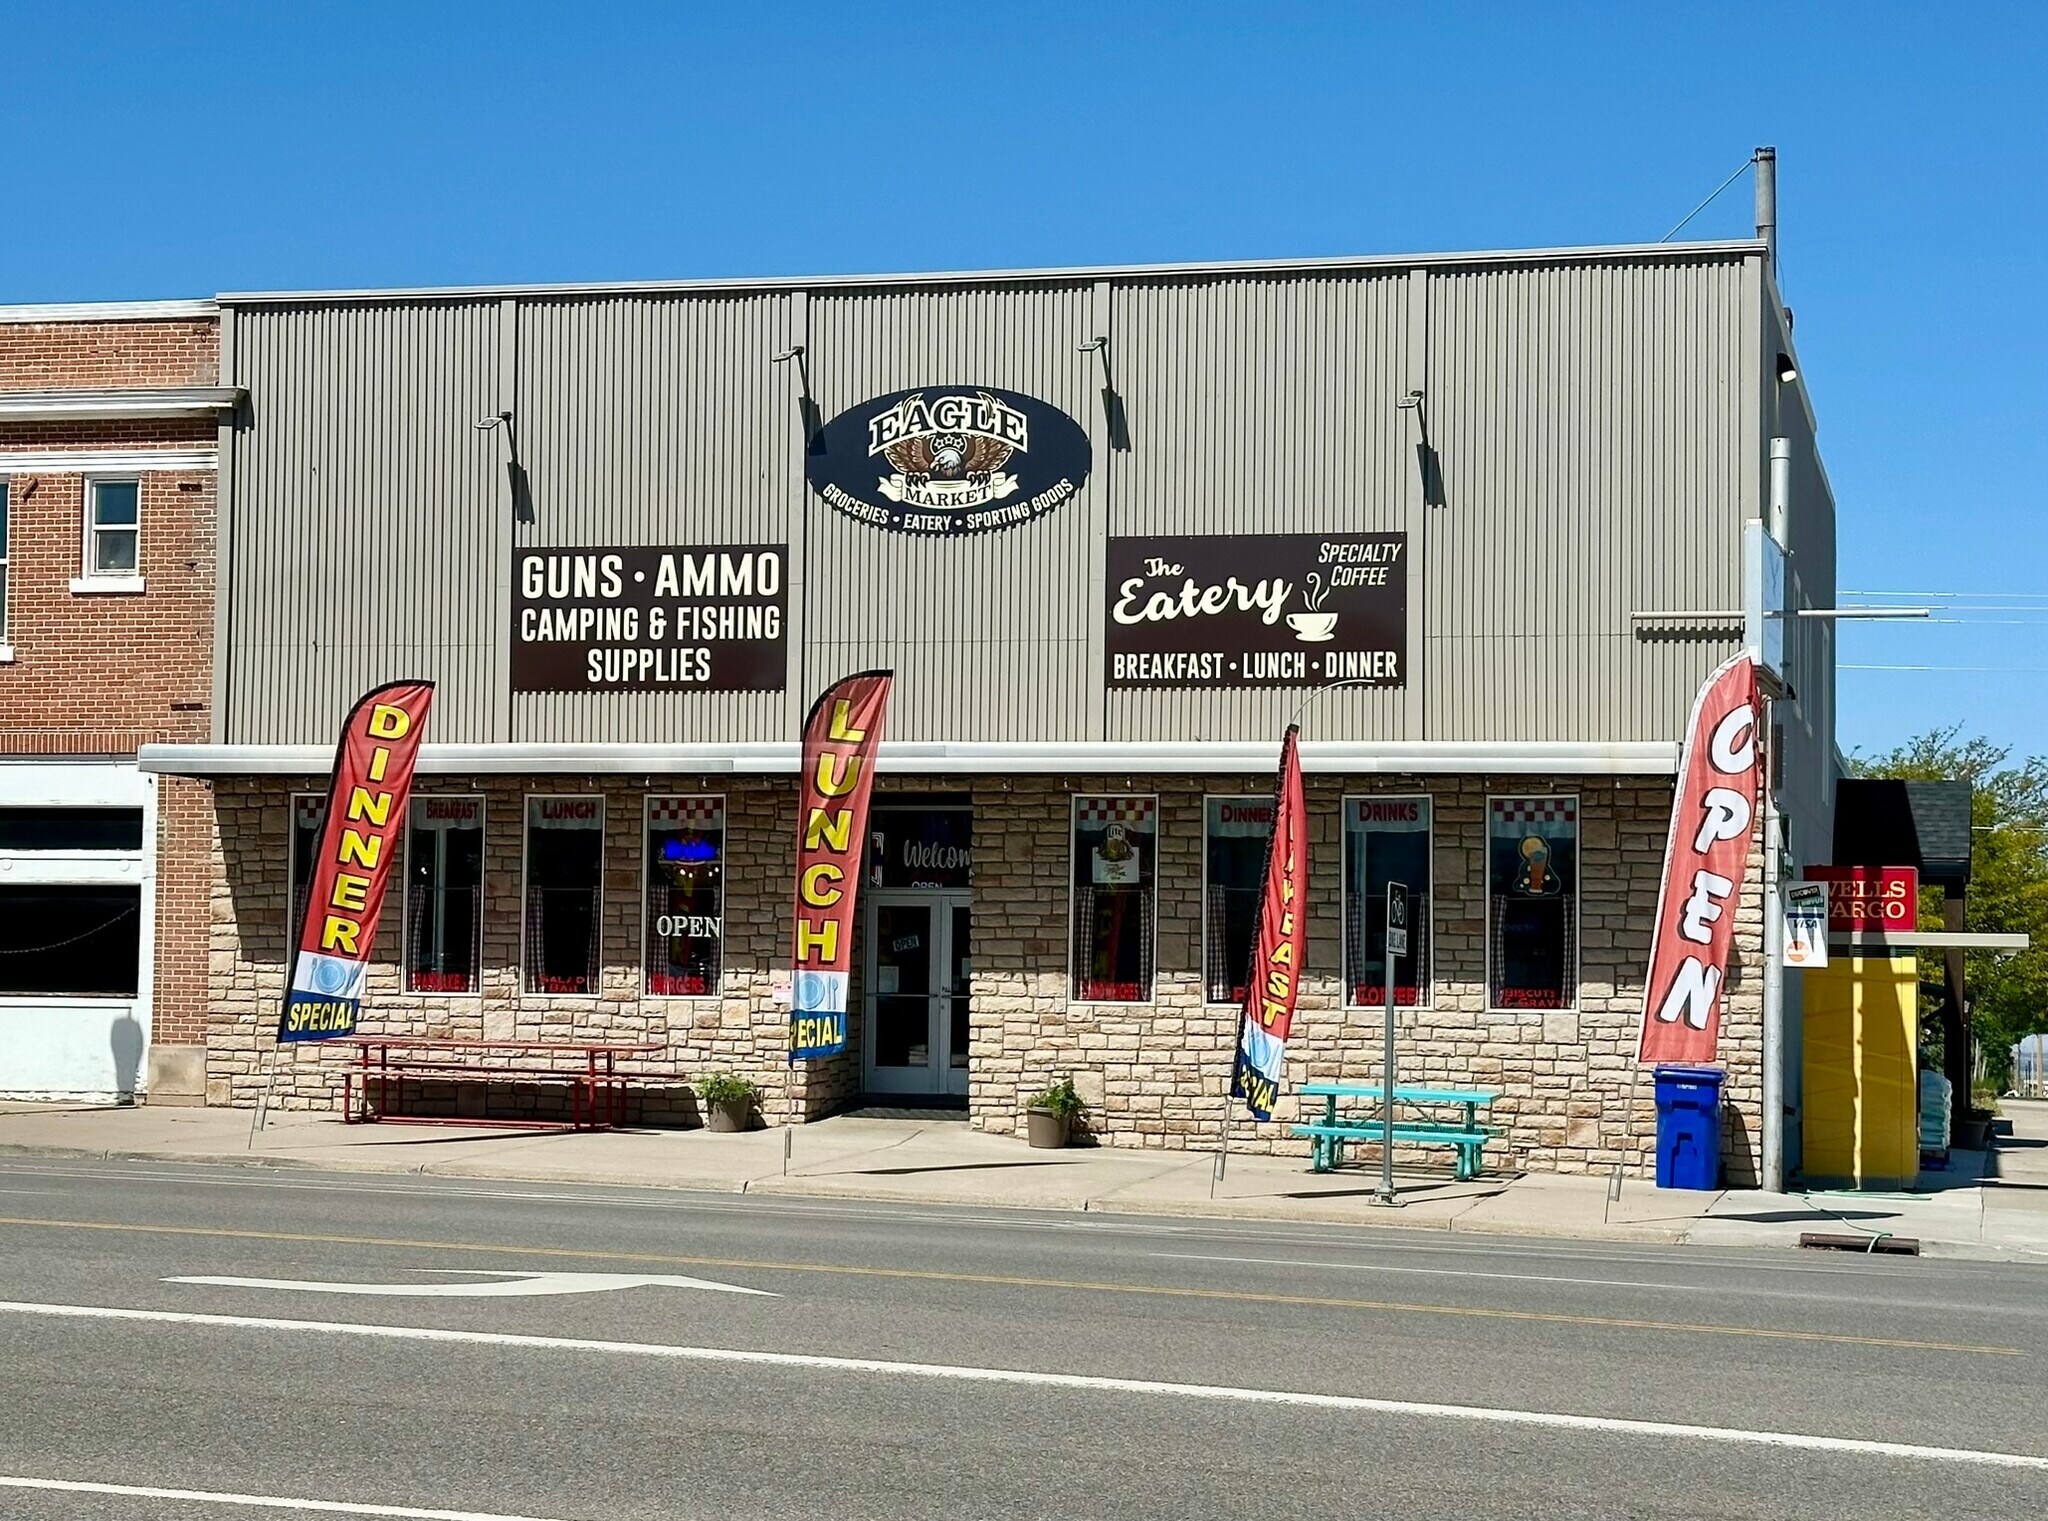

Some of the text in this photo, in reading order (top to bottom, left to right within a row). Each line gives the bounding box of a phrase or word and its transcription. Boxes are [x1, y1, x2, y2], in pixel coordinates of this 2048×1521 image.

[868, 396, 1028, 456] EAGLE
[822, 478, 1074, 531] GROCERIES EATERY SPORTING GOODS
[904, 486, 993, 506] MARKET
[1318, 542, 1402, 563] SPECIALTY
[521, 552, 780, 599] GUNS AMMO
[1144, 557, 1184, 577] The
[1330, 566, 1389, 587] COFFEE
[1112, 577, 1293, 625] Eatery
[521, 605, 780, 642] CAMPING & FISHING
[587, 647, 712, 683] SUPPLIES
[1113, 651, 1398, 679] BREAKFAST LUNCH DINNER
[427, 800, 478, 819] BREAKFAST
[542, 801, 596, 820] LUNCH
[1359, 802, 1418, 822] DRINKS
[320, 703, 411, 955] DINNER
[796, 698, 866, 963] LUNCH
[903, 839, 972, 869] Welcom
[1654, 703, 1756, 1031] OPEN
[1793, 919, 1817, 929] VISA
[1829, 901, 1907, 919] ARGO
[657, 915, 722, 937] OPEN
[895, 935, 917, 950] OPEN
[287, 1002, 354, 1033] SPECIAL
